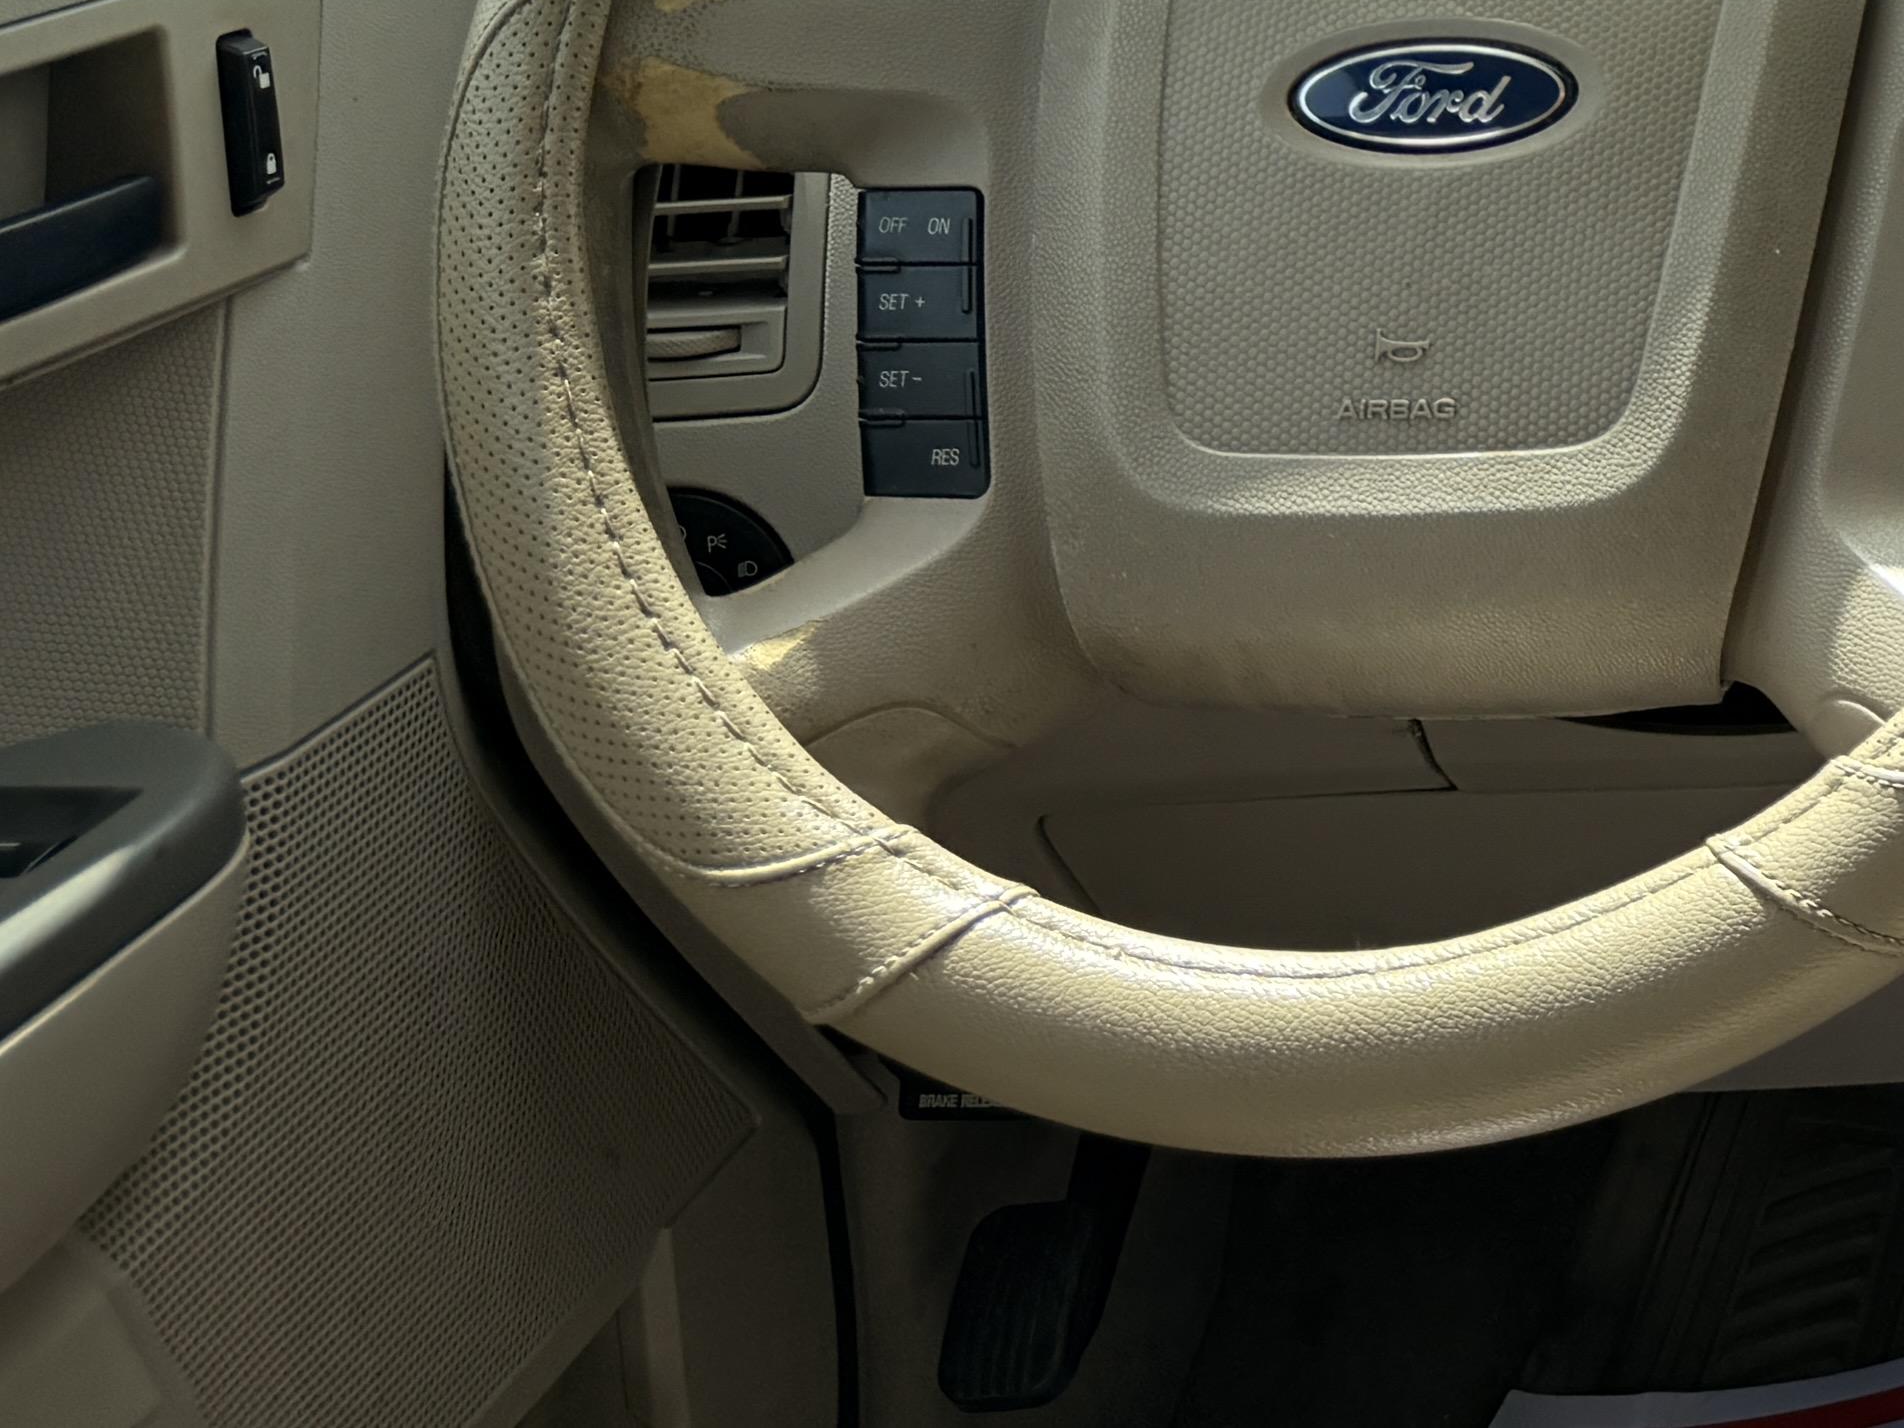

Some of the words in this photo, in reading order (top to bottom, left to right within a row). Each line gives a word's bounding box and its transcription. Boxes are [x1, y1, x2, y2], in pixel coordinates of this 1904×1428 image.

[1348, 60, 1511, 124] Ford
[878, 216, 908, 234] OFF
[927, 217, 951, 235] ON
[878, 293, 910, 311] SET
[879, 370, 909, 388] SET
[1336, 396, 1458, 421] AIRBAG
[931, 448, 961, 466] RES
